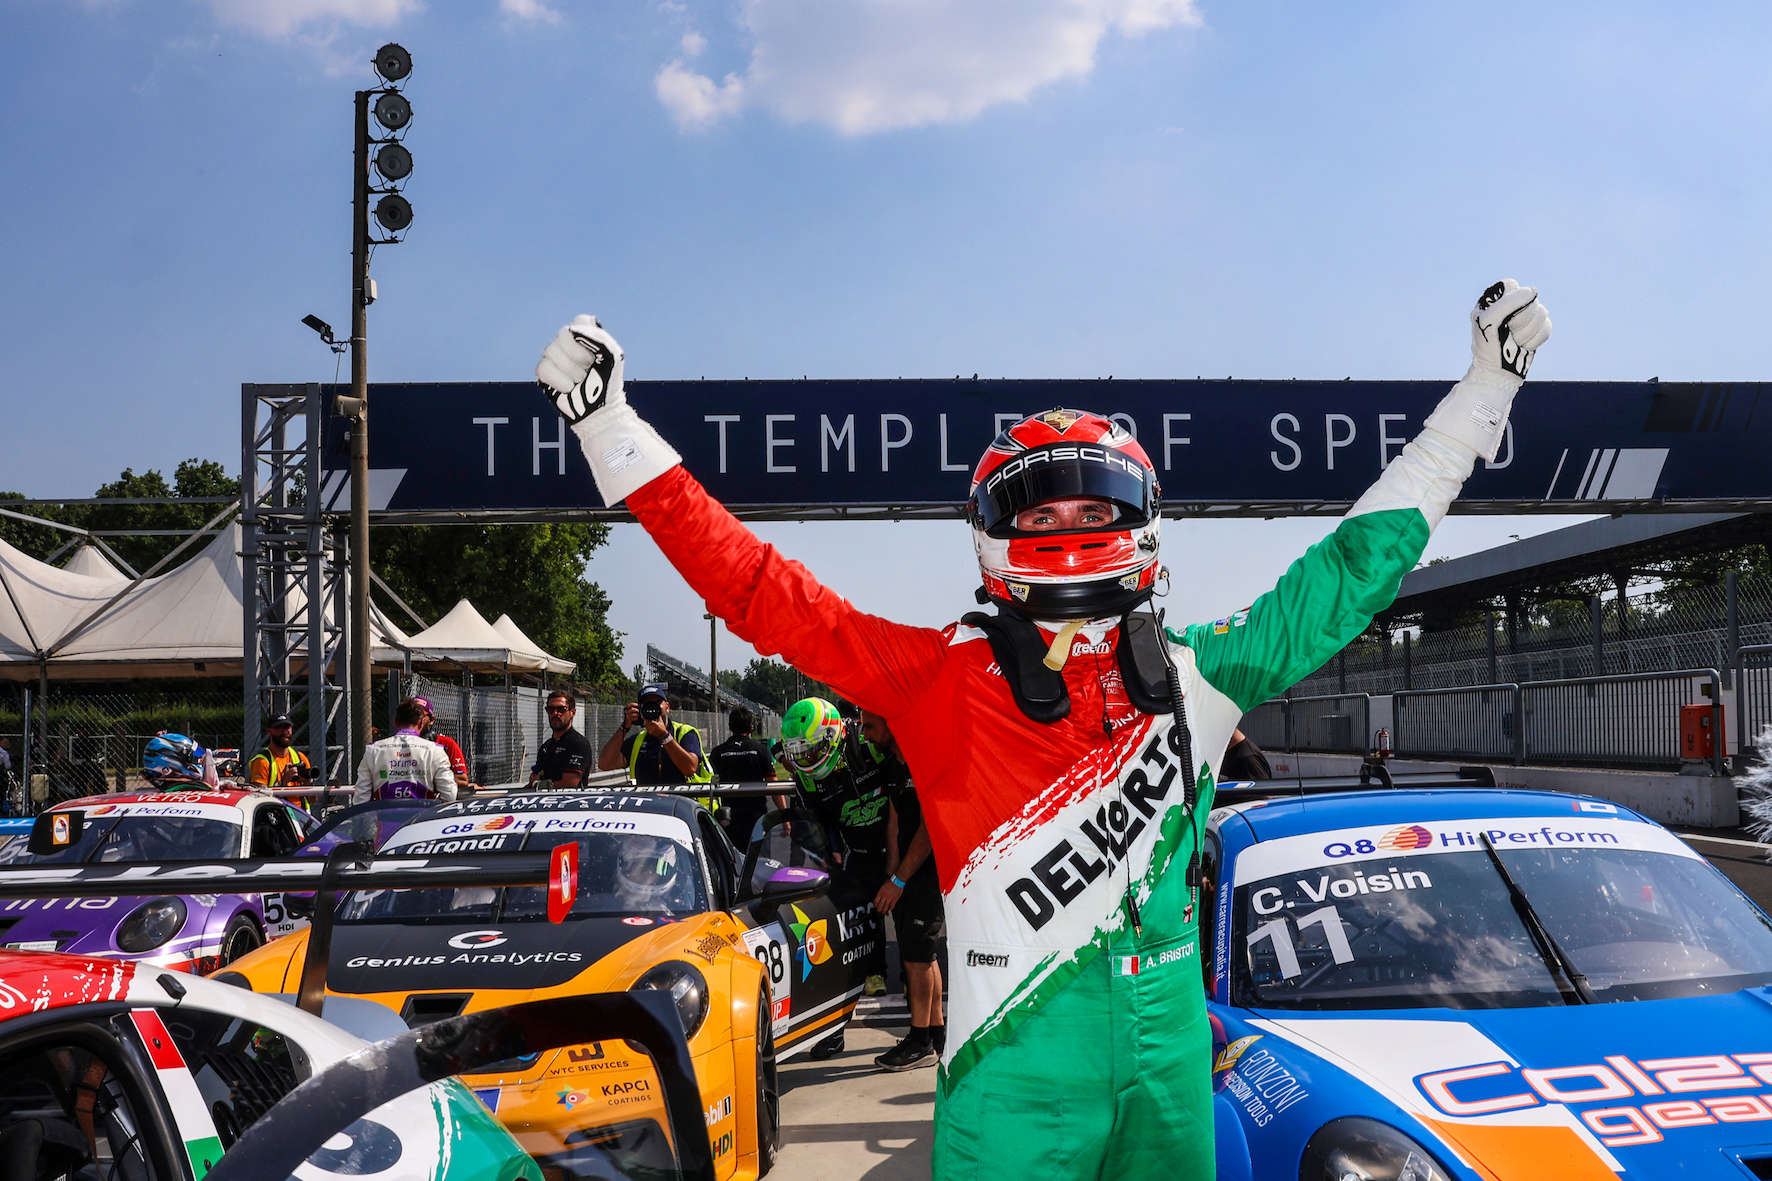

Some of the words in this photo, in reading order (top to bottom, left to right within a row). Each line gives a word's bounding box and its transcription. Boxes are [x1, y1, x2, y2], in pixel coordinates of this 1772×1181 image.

[473, 416, 566, 476] TH
[1270, 411, 1514, 471] SPED
[987, 447, 1143, 495] PORSCHE
[1072, 641, 1111, 657] freem
[720, 749, 757, 758] PORSCHE
[389, 759, 418, 769] prima
[137, 794, 202, 803] VETRO
[394, 786, 412, 799] 56
[113, 806, 132, 816] Hi
[136, 806, 202, 816] Perform
[437, 796, 653, 813] ALENEXT.IT
[457, 802, 565, 815] SOFTWARE
[442, 822, 475, 835] Q8
[514, 820, 538, 830] Hi
[545, 817, 636, 830] Perform
[406, 835, 507, 855] Girondi
[1323, 839, 1376, 858] Q8
[1440, 830, 1474, 847] Hi
[1488, 827, 1619, 846] Perform
[1252, 887, 1295, 915] C.
[1297, 867, 1432, 902] Voisin
[278, 923, 295, 932] HDI
[1216, 882, 1229, 982] www.carreracupitalia.it
[1246, 905, 1355, 979] 11
[346, 955, 447, 968] Genius
[451, 952, 583, 966] Analytics
[966, 950, 1010, 968] freem
[1146, 956, 1157, 969] A.
[1159, 942, 1195, 962] BRISTOT
[550, 1066, 575, 1076] WTC
[578, 1060, 630, 1072] SERVICES
[601, 1079, 650, 1097] KAPCI
[1238, 1049, 1309, 1114] RONZONI
[608, 1094, 652, 1106] COATINGS
[1222, 1070, 1255, 1103] PRECISION
[1244, 1096, 1274, 1128] TOOLS
[704, 1100, 723, 1127] obil
[1581, 1094, 1772, 1147] gea
[712, 1130, 733, 1161] HDI
